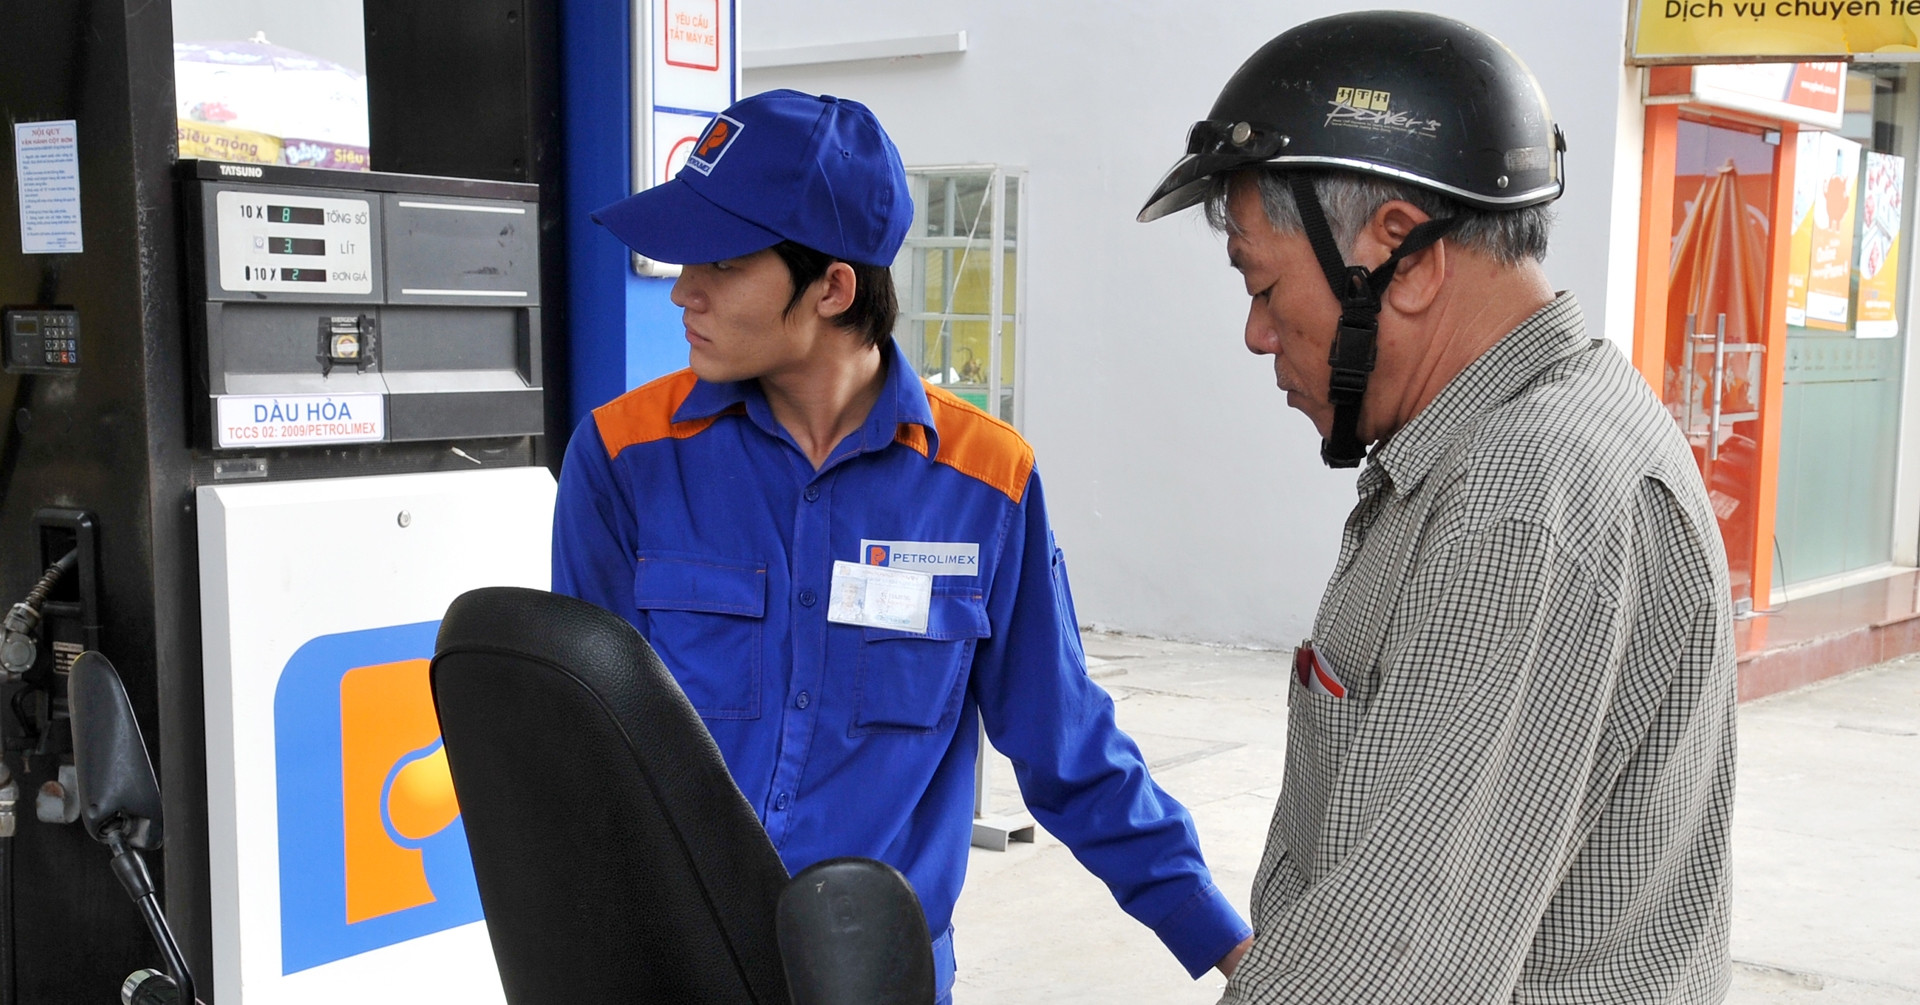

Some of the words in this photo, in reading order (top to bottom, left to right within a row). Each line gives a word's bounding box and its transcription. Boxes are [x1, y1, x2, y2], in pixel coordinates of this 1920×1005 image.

[1665, 0, 1723, 22] Dịch
[1734, 2, 1765, 21] vụ
[704, 34, 714, 46] XE
[219, 165, 263, 178] TATSUNO
[240, 205, 252, 219] 10
[256, 206, 263, 219] X
[282, 207, 290, 222] 8
[254, 267, 266, 281] 10
[292, 269, 299, 280] 2
[228, 426, 259, 439] TCCS
[262, 425, 278, 438] 02:
[893, 553, 976, 565] PETROLIMEX
